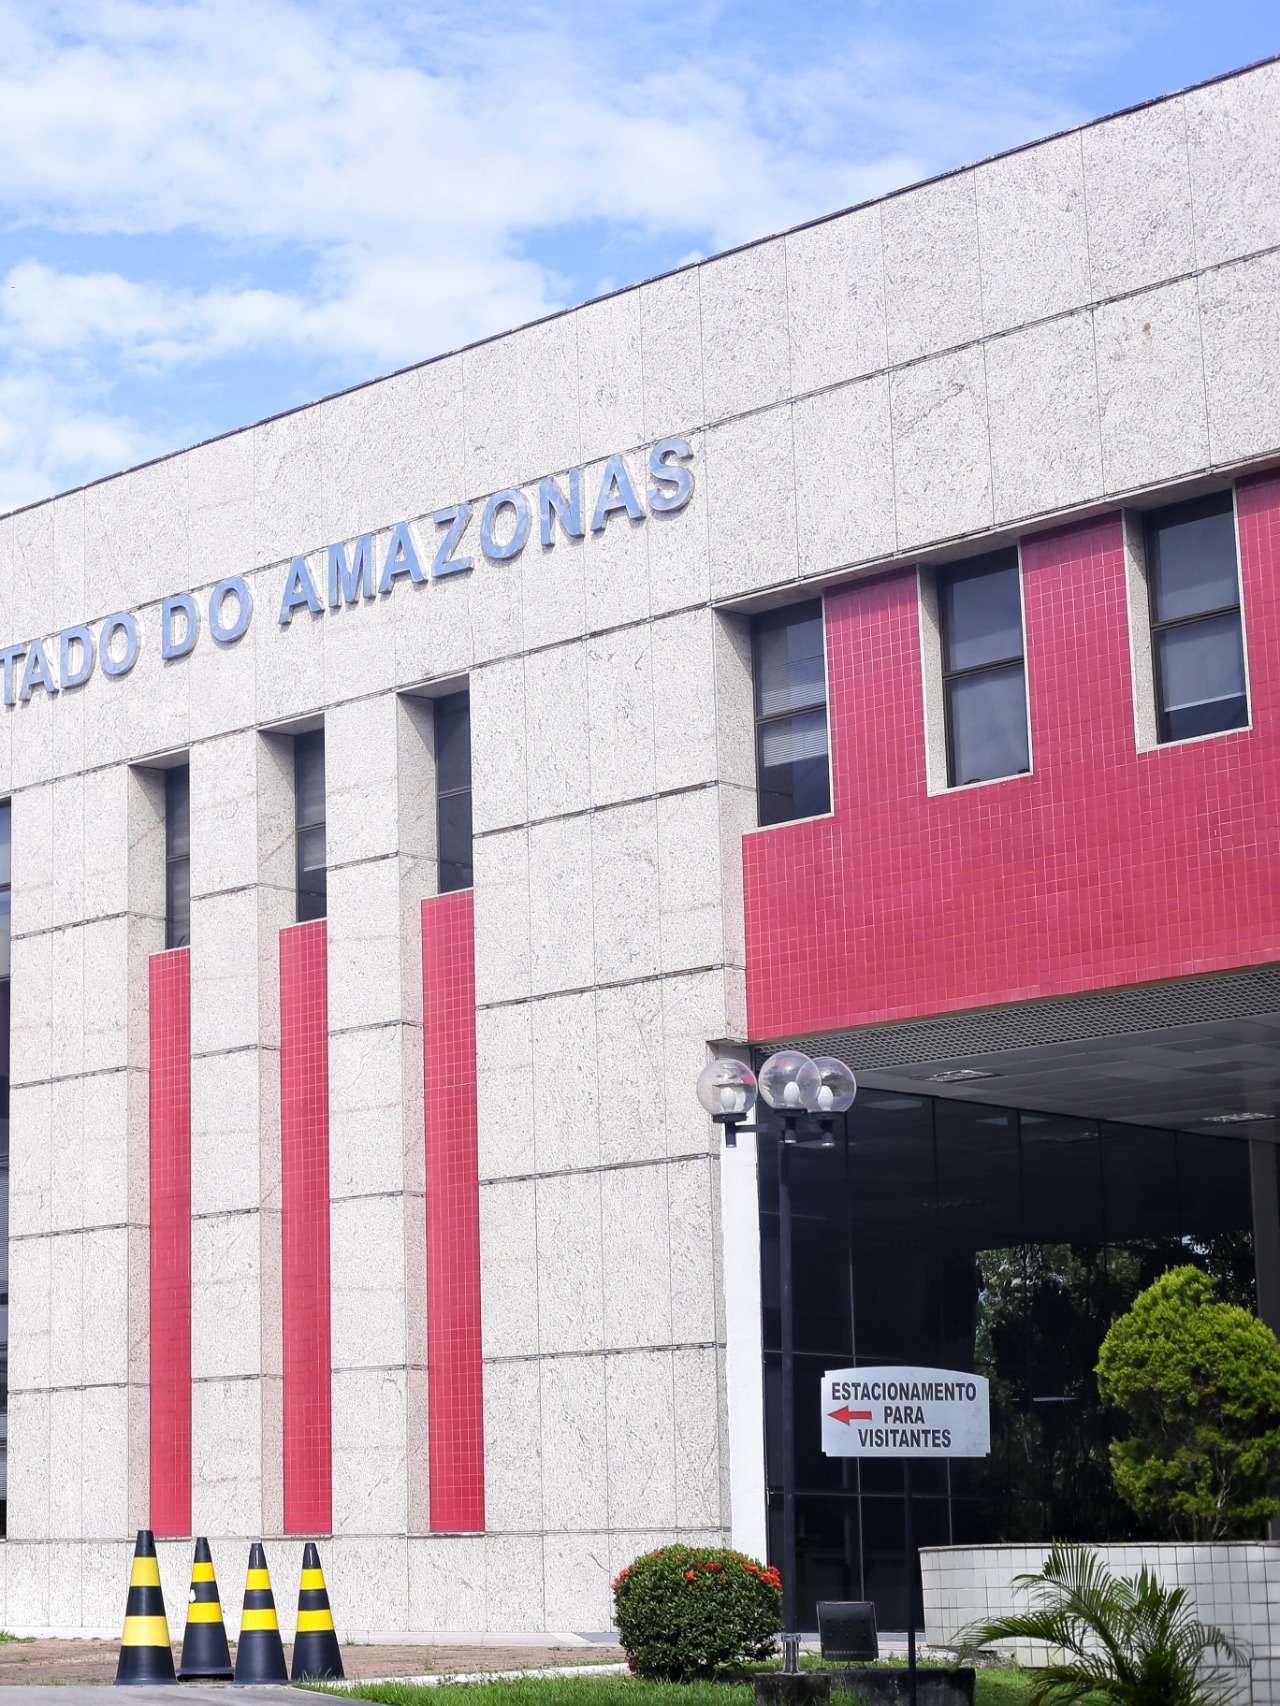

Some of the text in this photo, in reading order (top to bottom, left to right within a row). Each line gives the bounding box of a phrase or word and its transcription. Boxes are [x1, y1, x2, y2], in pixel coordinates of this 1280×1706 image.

[161, 577, 253, 661] DO
[278, 437, 695, 626] AMAZONAS
[831, 1381, 977, 1401] ESTACIONAMENTO
[883, 1405, 926, 1424] PARA
[857, 1428, 952, 1448] VISITANTES
